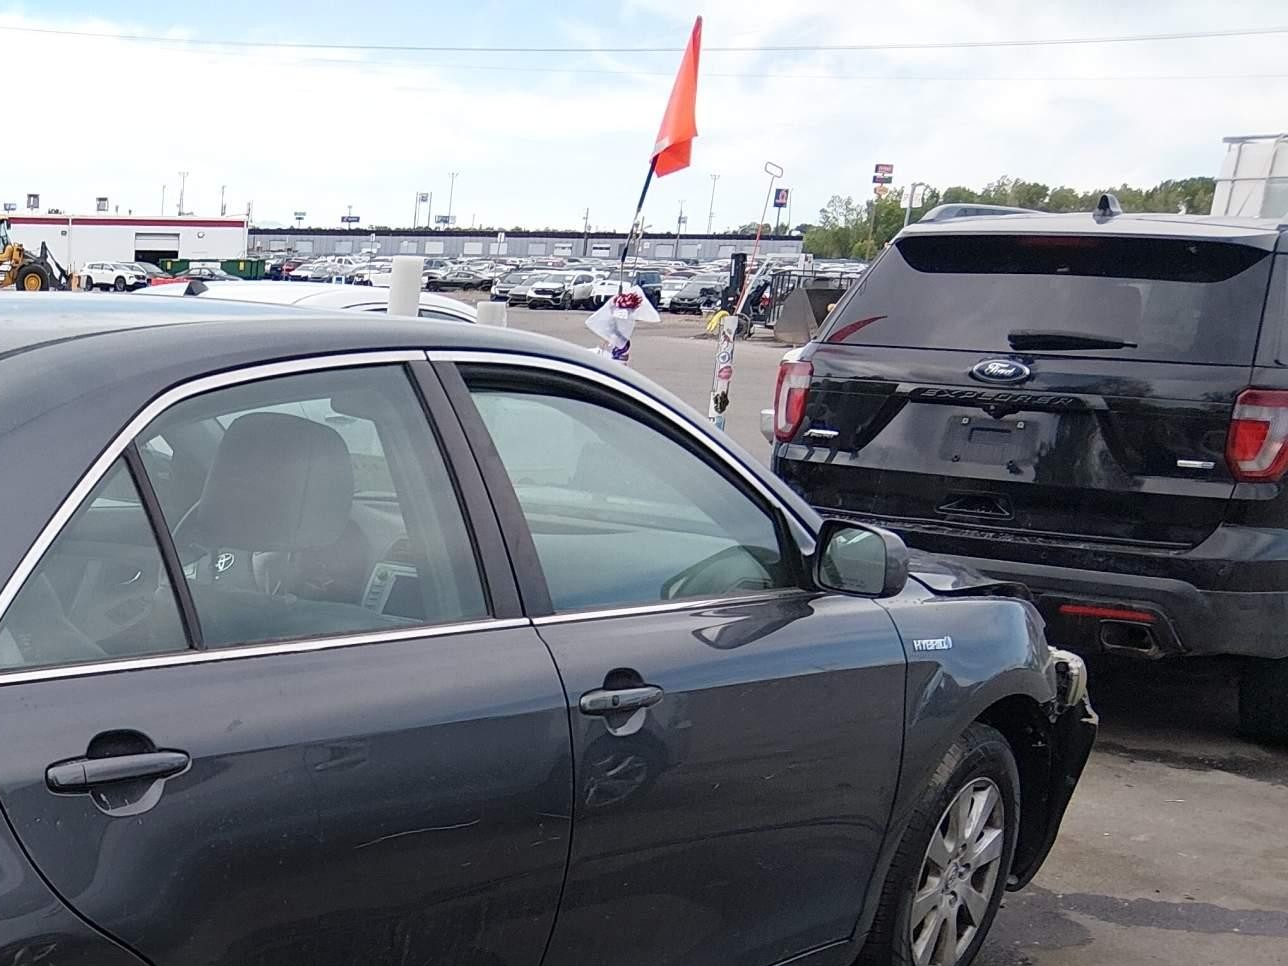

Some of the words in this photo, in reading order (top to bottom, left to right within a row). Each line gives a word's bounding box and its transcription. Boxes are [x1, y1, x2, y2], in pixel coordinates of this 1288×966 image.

[984, 362, 1016, 376] Ford
[920, 388, 1074, 406] EXPLORER
[913, 638, 948, 651] HYBRID
